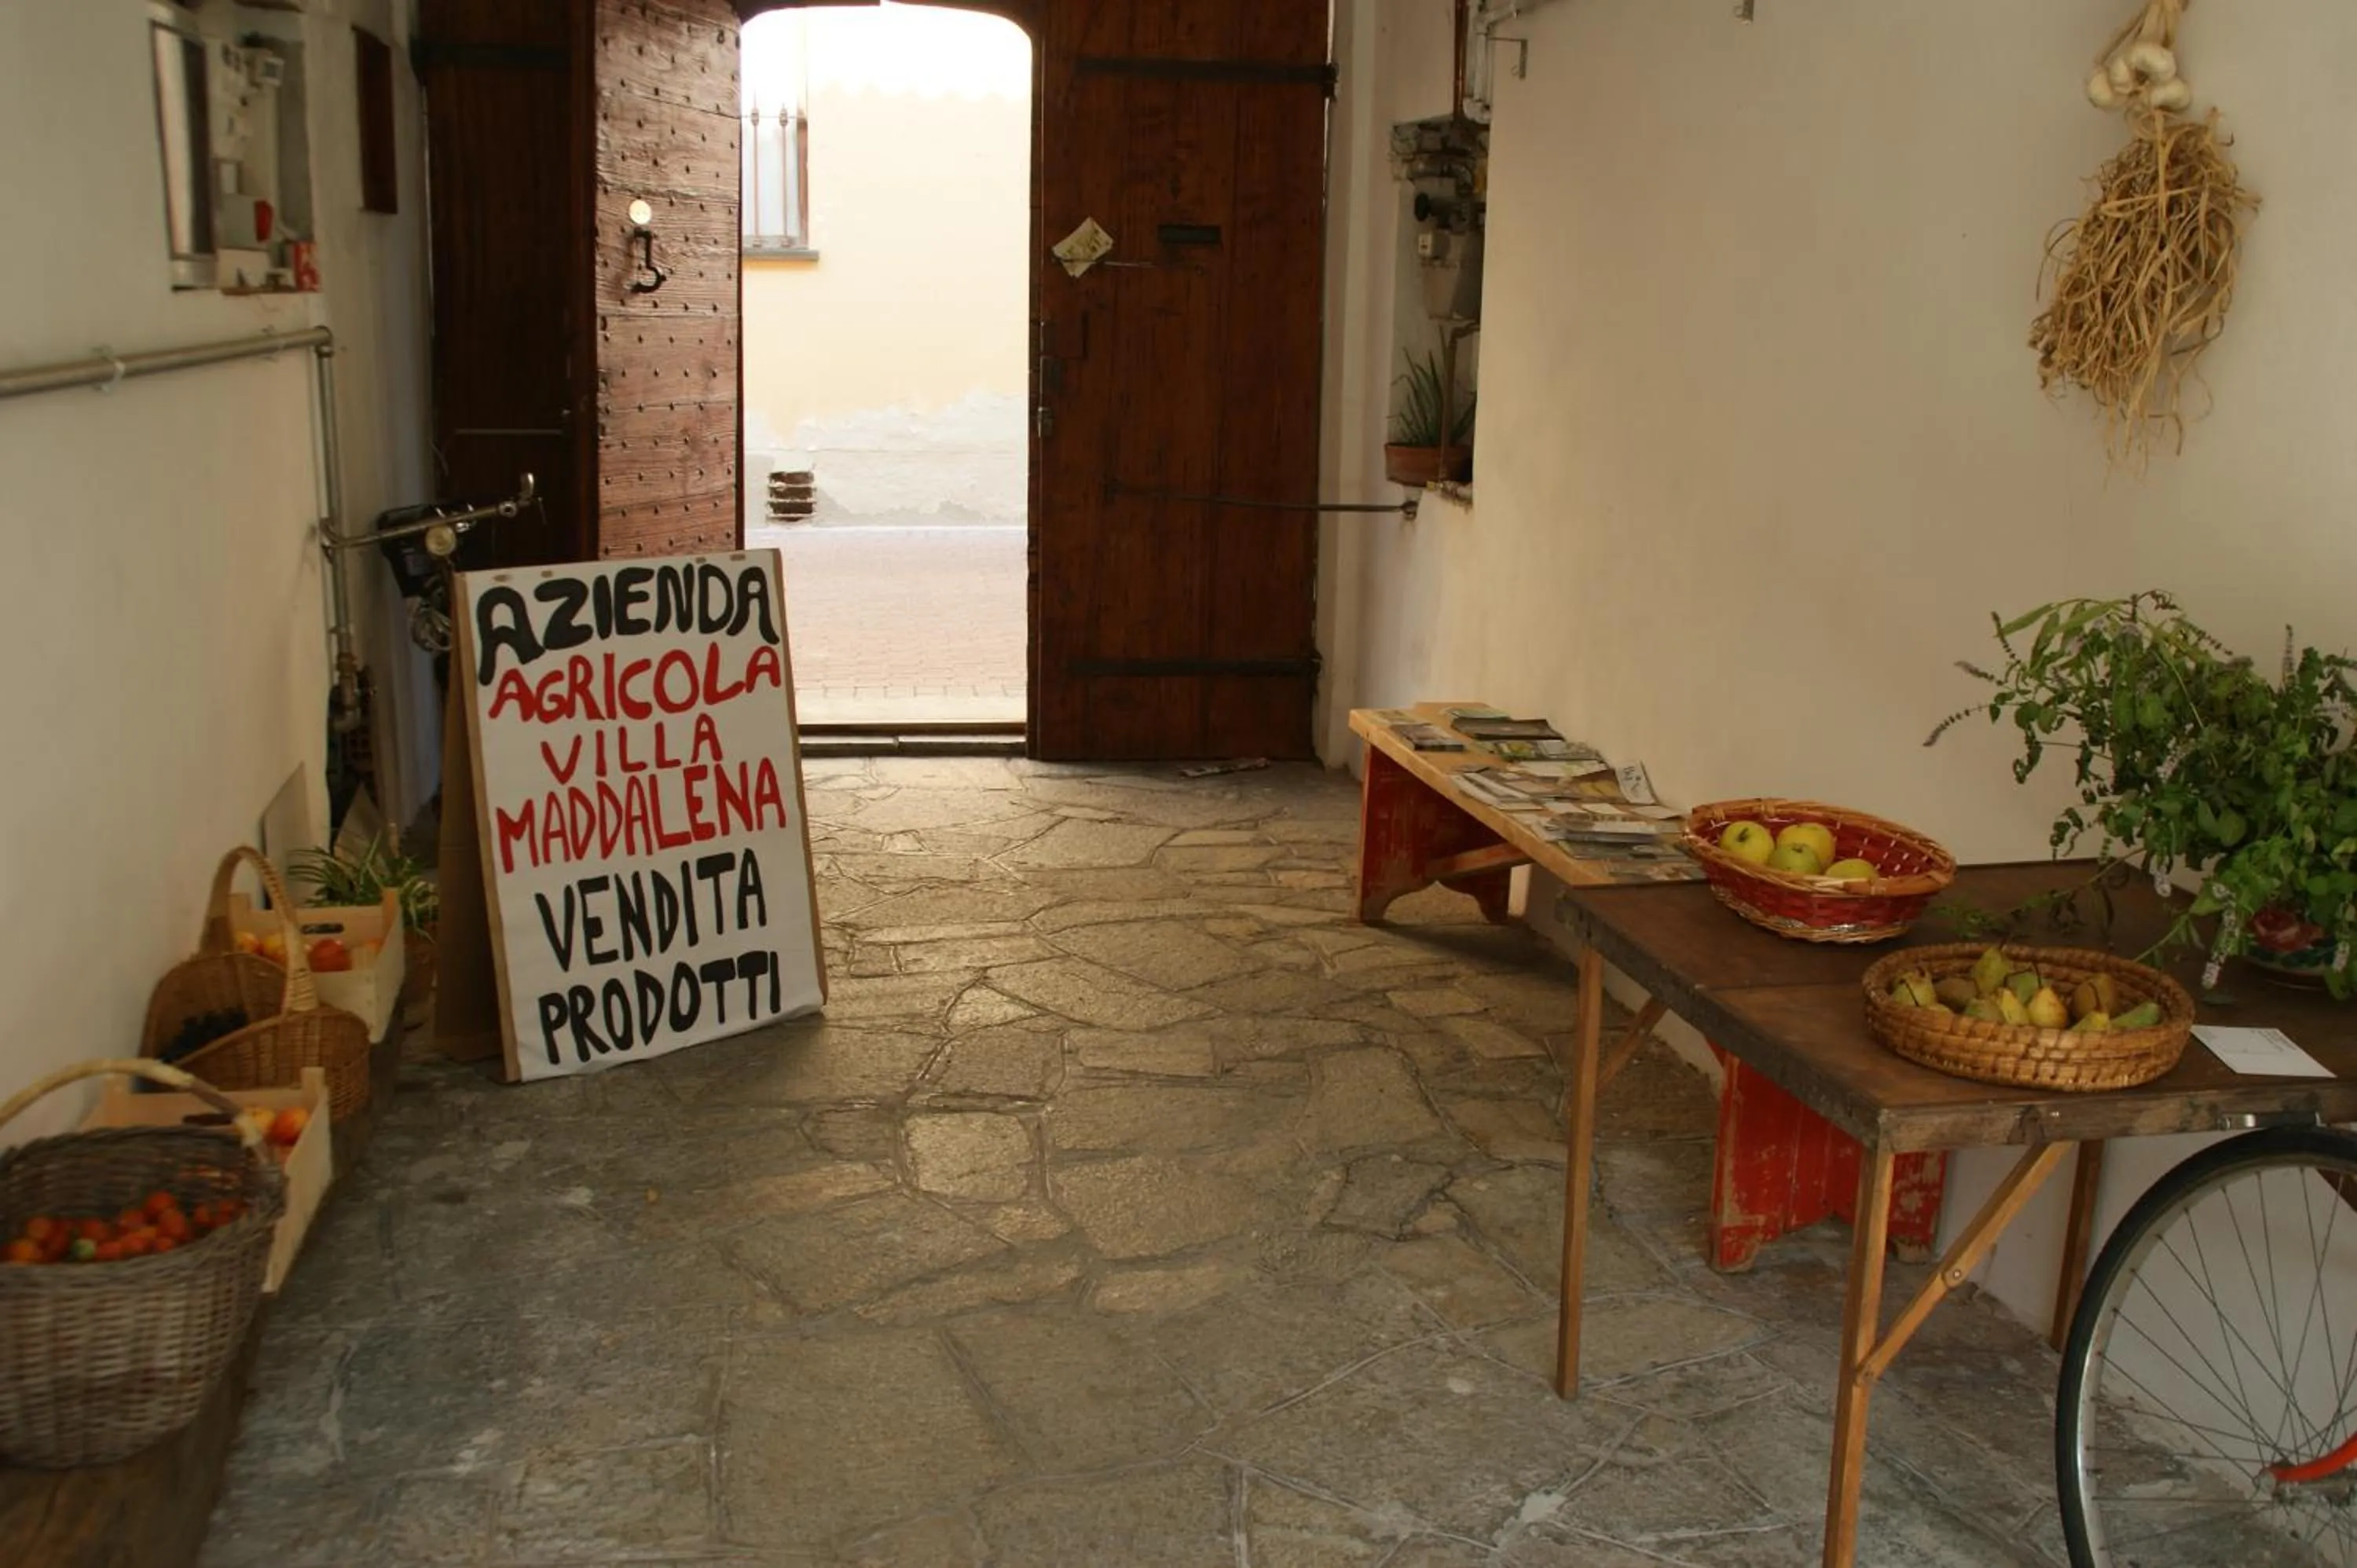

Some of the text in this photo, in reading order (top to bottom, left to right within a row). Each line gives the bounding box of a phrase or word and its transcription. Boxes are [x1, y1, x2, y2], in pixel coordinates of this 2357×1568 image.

[477, 563, 779, 686] AZIENDA
[489, 642, 781, 720] AGRICOLA
[541, 713, 723, 784] VILLA
[496, 757, 786, 873] MADDALENA
[535, 848, 766, 973] VENDITA
[537, 951, 781, 1064] PRODOTTI
